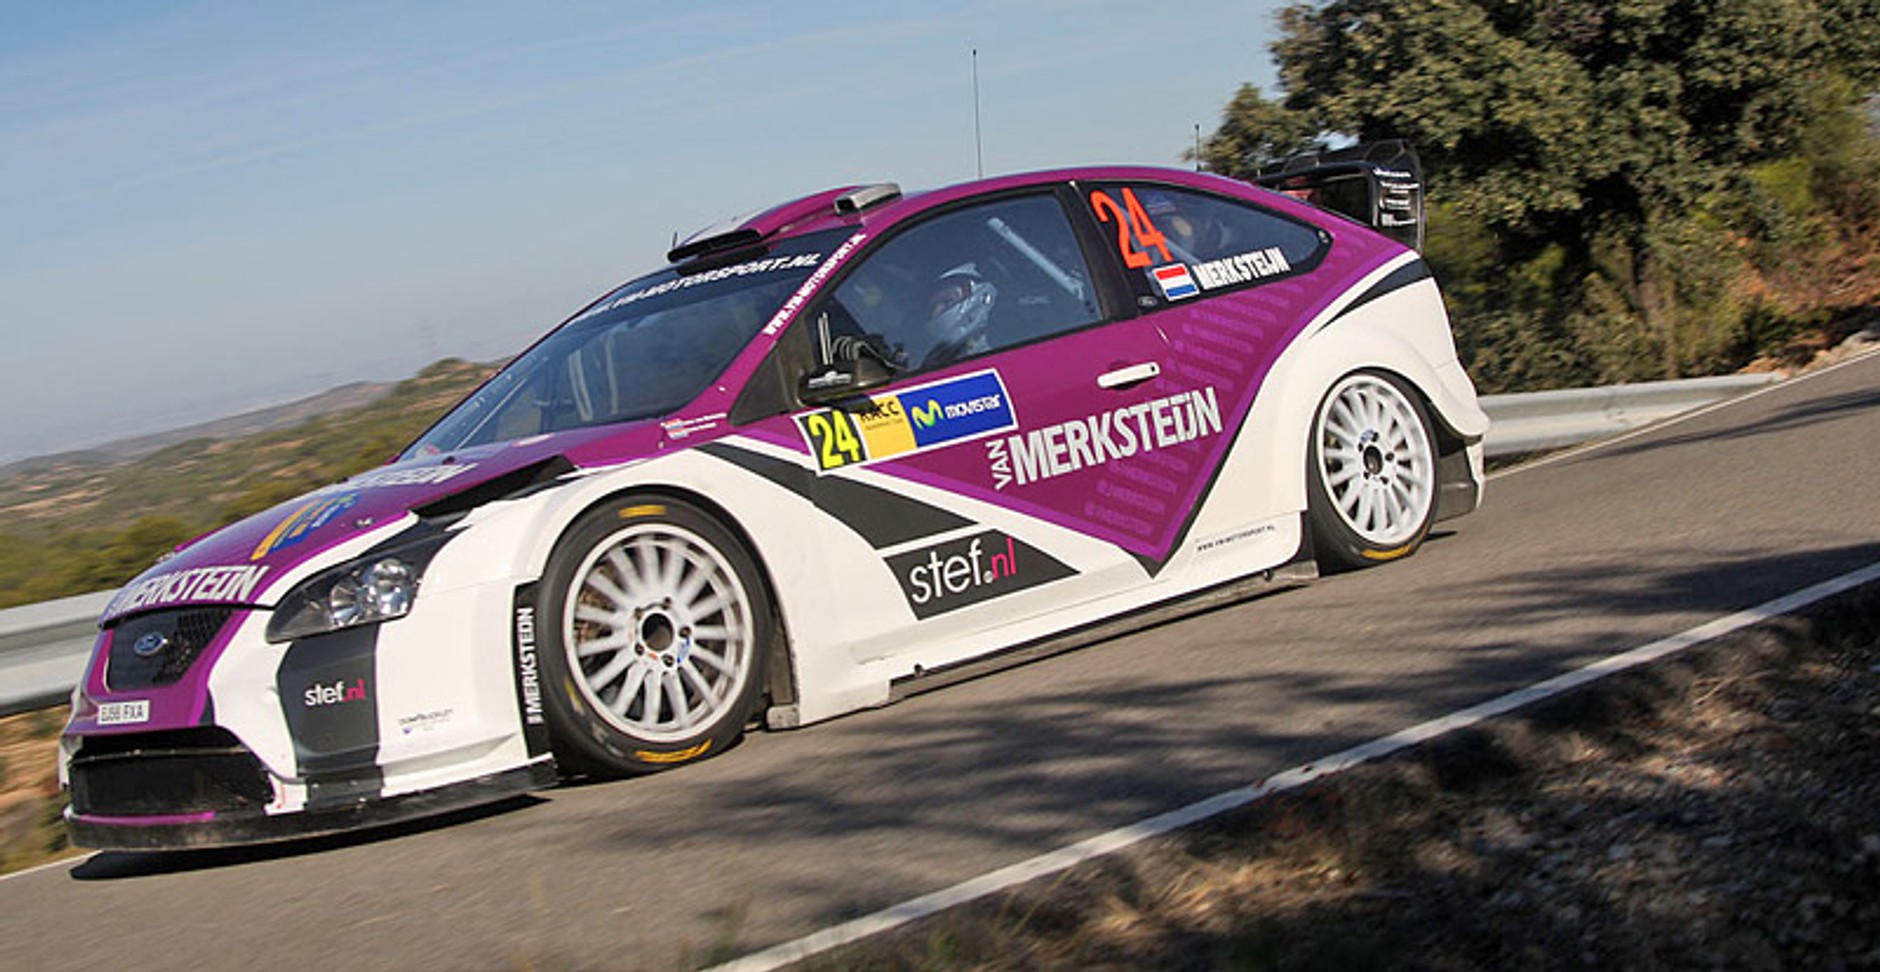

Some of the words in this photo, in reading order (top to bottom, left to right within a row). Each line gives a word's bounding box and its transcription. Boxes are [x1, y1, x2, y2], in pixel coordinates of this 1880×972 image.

[1090, 187, 1173, 268] 24
[808, 411, 860, 469] 24
[986, 438, 1012, 490] VAN
[1008, 387, 1223, 486] MERKSTEIJN
[909, 535, 1017, 604] stef.nl
[304, 678, 366, 707] stef.nl
